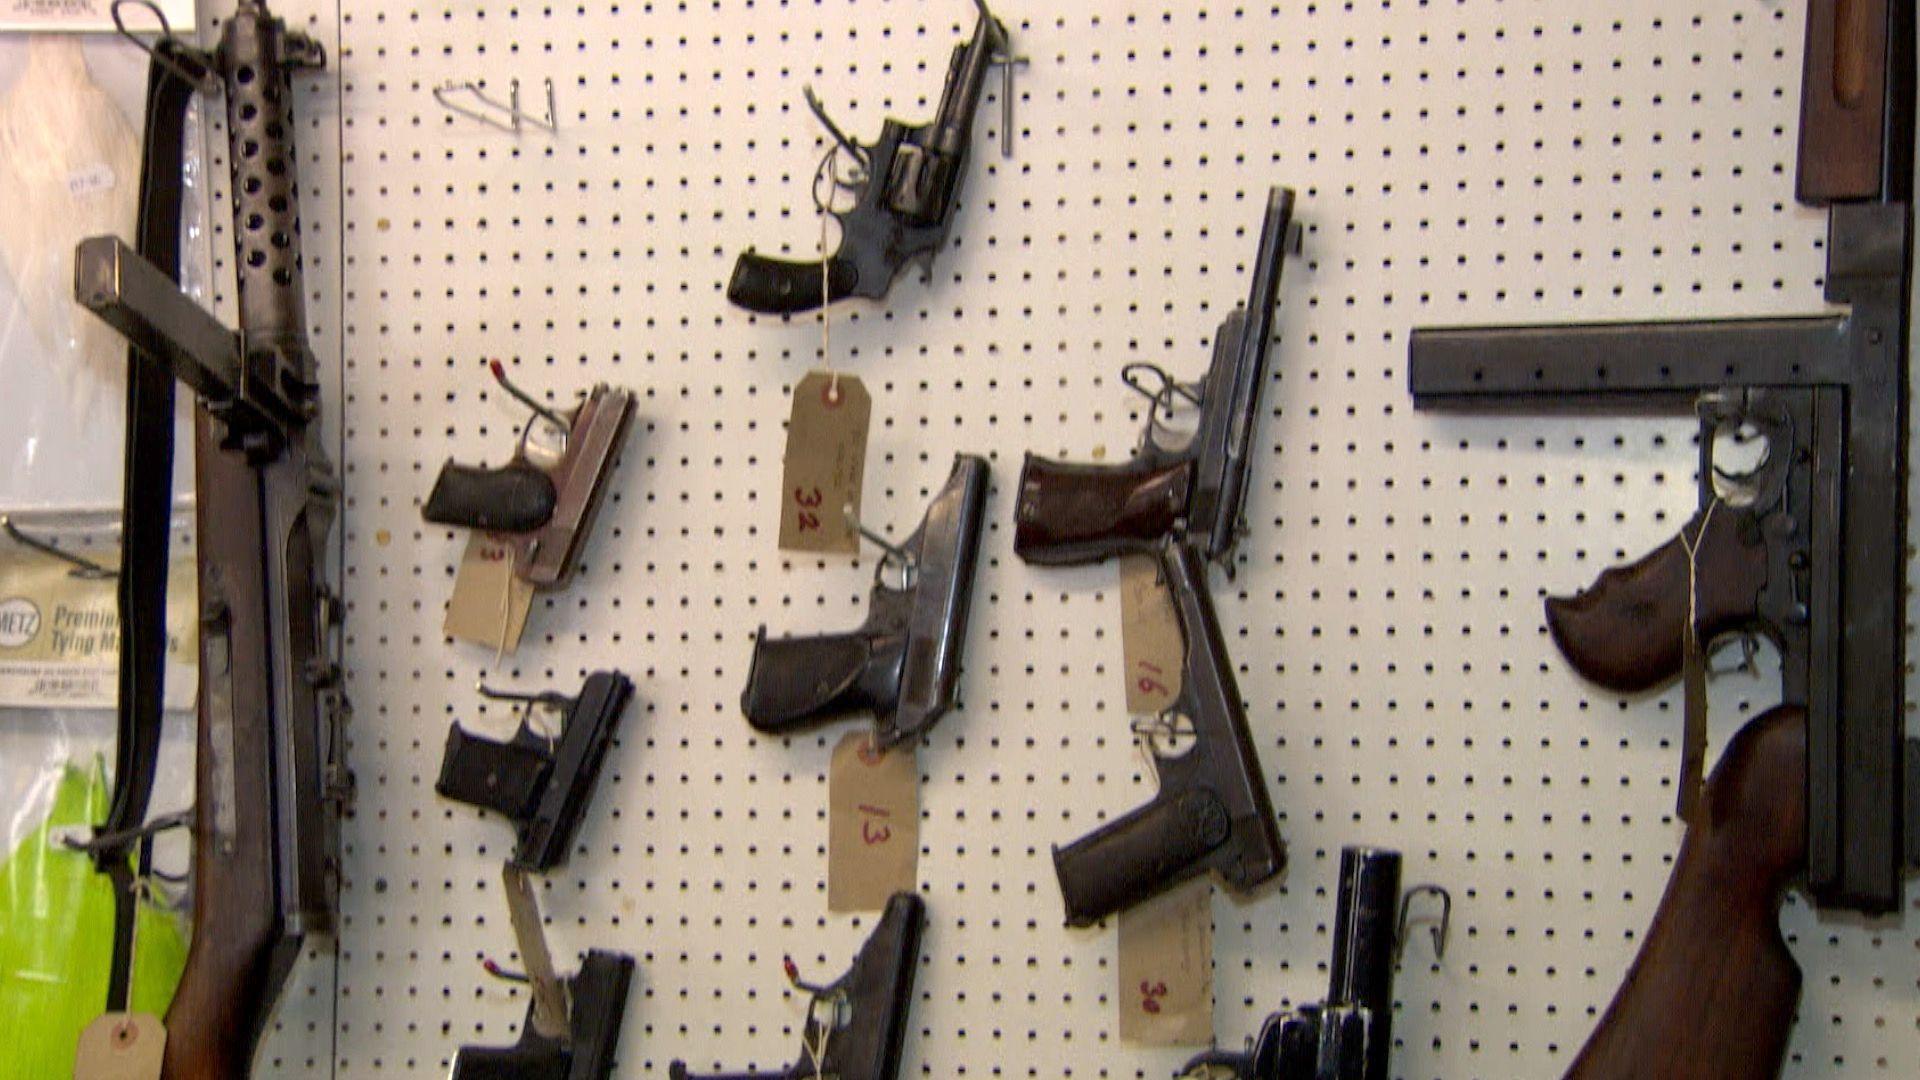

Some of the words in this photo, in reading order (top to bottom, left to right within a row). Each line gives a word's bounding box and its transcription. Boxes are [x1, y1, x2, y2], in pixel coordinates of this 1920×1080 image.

[795, 485, 822, 533] 32
[54, 605, 119, 627] Premiu
[52, 630, 95, 656] Tying
[1138, 661, 1169, 697] 16
[858, 804, 891, 846] 13
